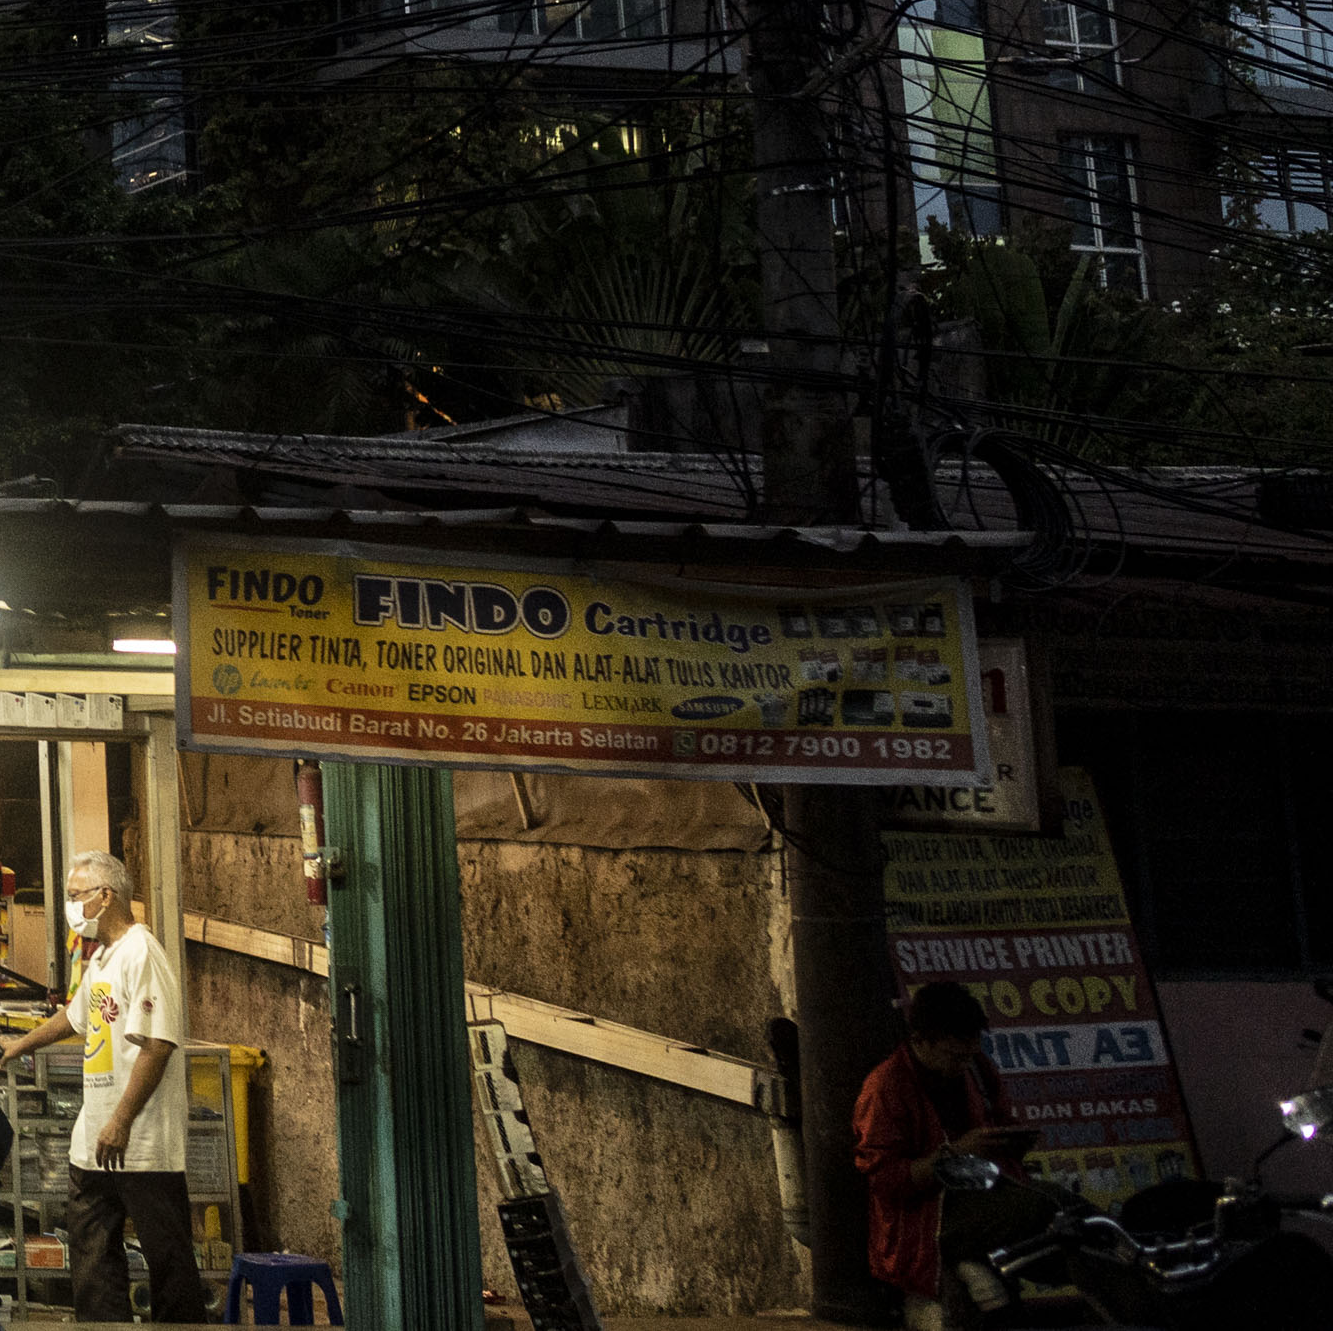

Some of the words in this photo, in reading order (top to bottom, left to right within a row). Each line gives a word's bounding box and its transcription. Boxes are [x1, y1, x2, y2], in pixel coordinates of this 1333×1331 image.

[207, 567, 324, 605] FINDO
[289, 605, 330, 620] Toner
[353, 573, 570, 640] FINDO
[585, 602, 773, 653] Cartridge
[212, 628, 302, 662] SUPPLIER
[310, 635, 367, 671] TINTA,
[376, 640, 436, 671] TONER
[443, 644, 525, 678] ORIGINAL
[531, 650, 566, 680] DAN
[574, 653, 663, 685] ALAT-ALAT
[666, 658, 715, 688] TULIS
[719, 662, 795, 690] KANTOR
[326, 678, 395, 698] Canon
[408, 684, 477, 704] EPSON
[483, 689, 572, 709] PANASONIC
[582, 692, 664, 713] LEXMARK
[680, 699, 739, 715] SAMSUNG
[207, 704, 231, 724] Jl.
[238, 705, 342, 733] Setiabudi
[350, 715, 410, 739] Barat
[417, 720, 454, 741] No.
[462, 722, 488, 741] 26
[494, 723, 573, 748] Jakarta
[579, 726, 659, 750] Selatan
[701, 733, 773, 755] 0812
[784, 737, 861, 758] 7900
[874, 738, 952, 760] 1982
[895, 936, 1014, 973] SERVICE
[1013, 932, 1134, 969] PRINTER
[1029, 974, 1138, 1016] COPY
[1093, 1027, 1154, 1064] A3
[1026, 1102, 1073, 1121] DAN
[1079, 1097, 1158, 1118] BAKAS
